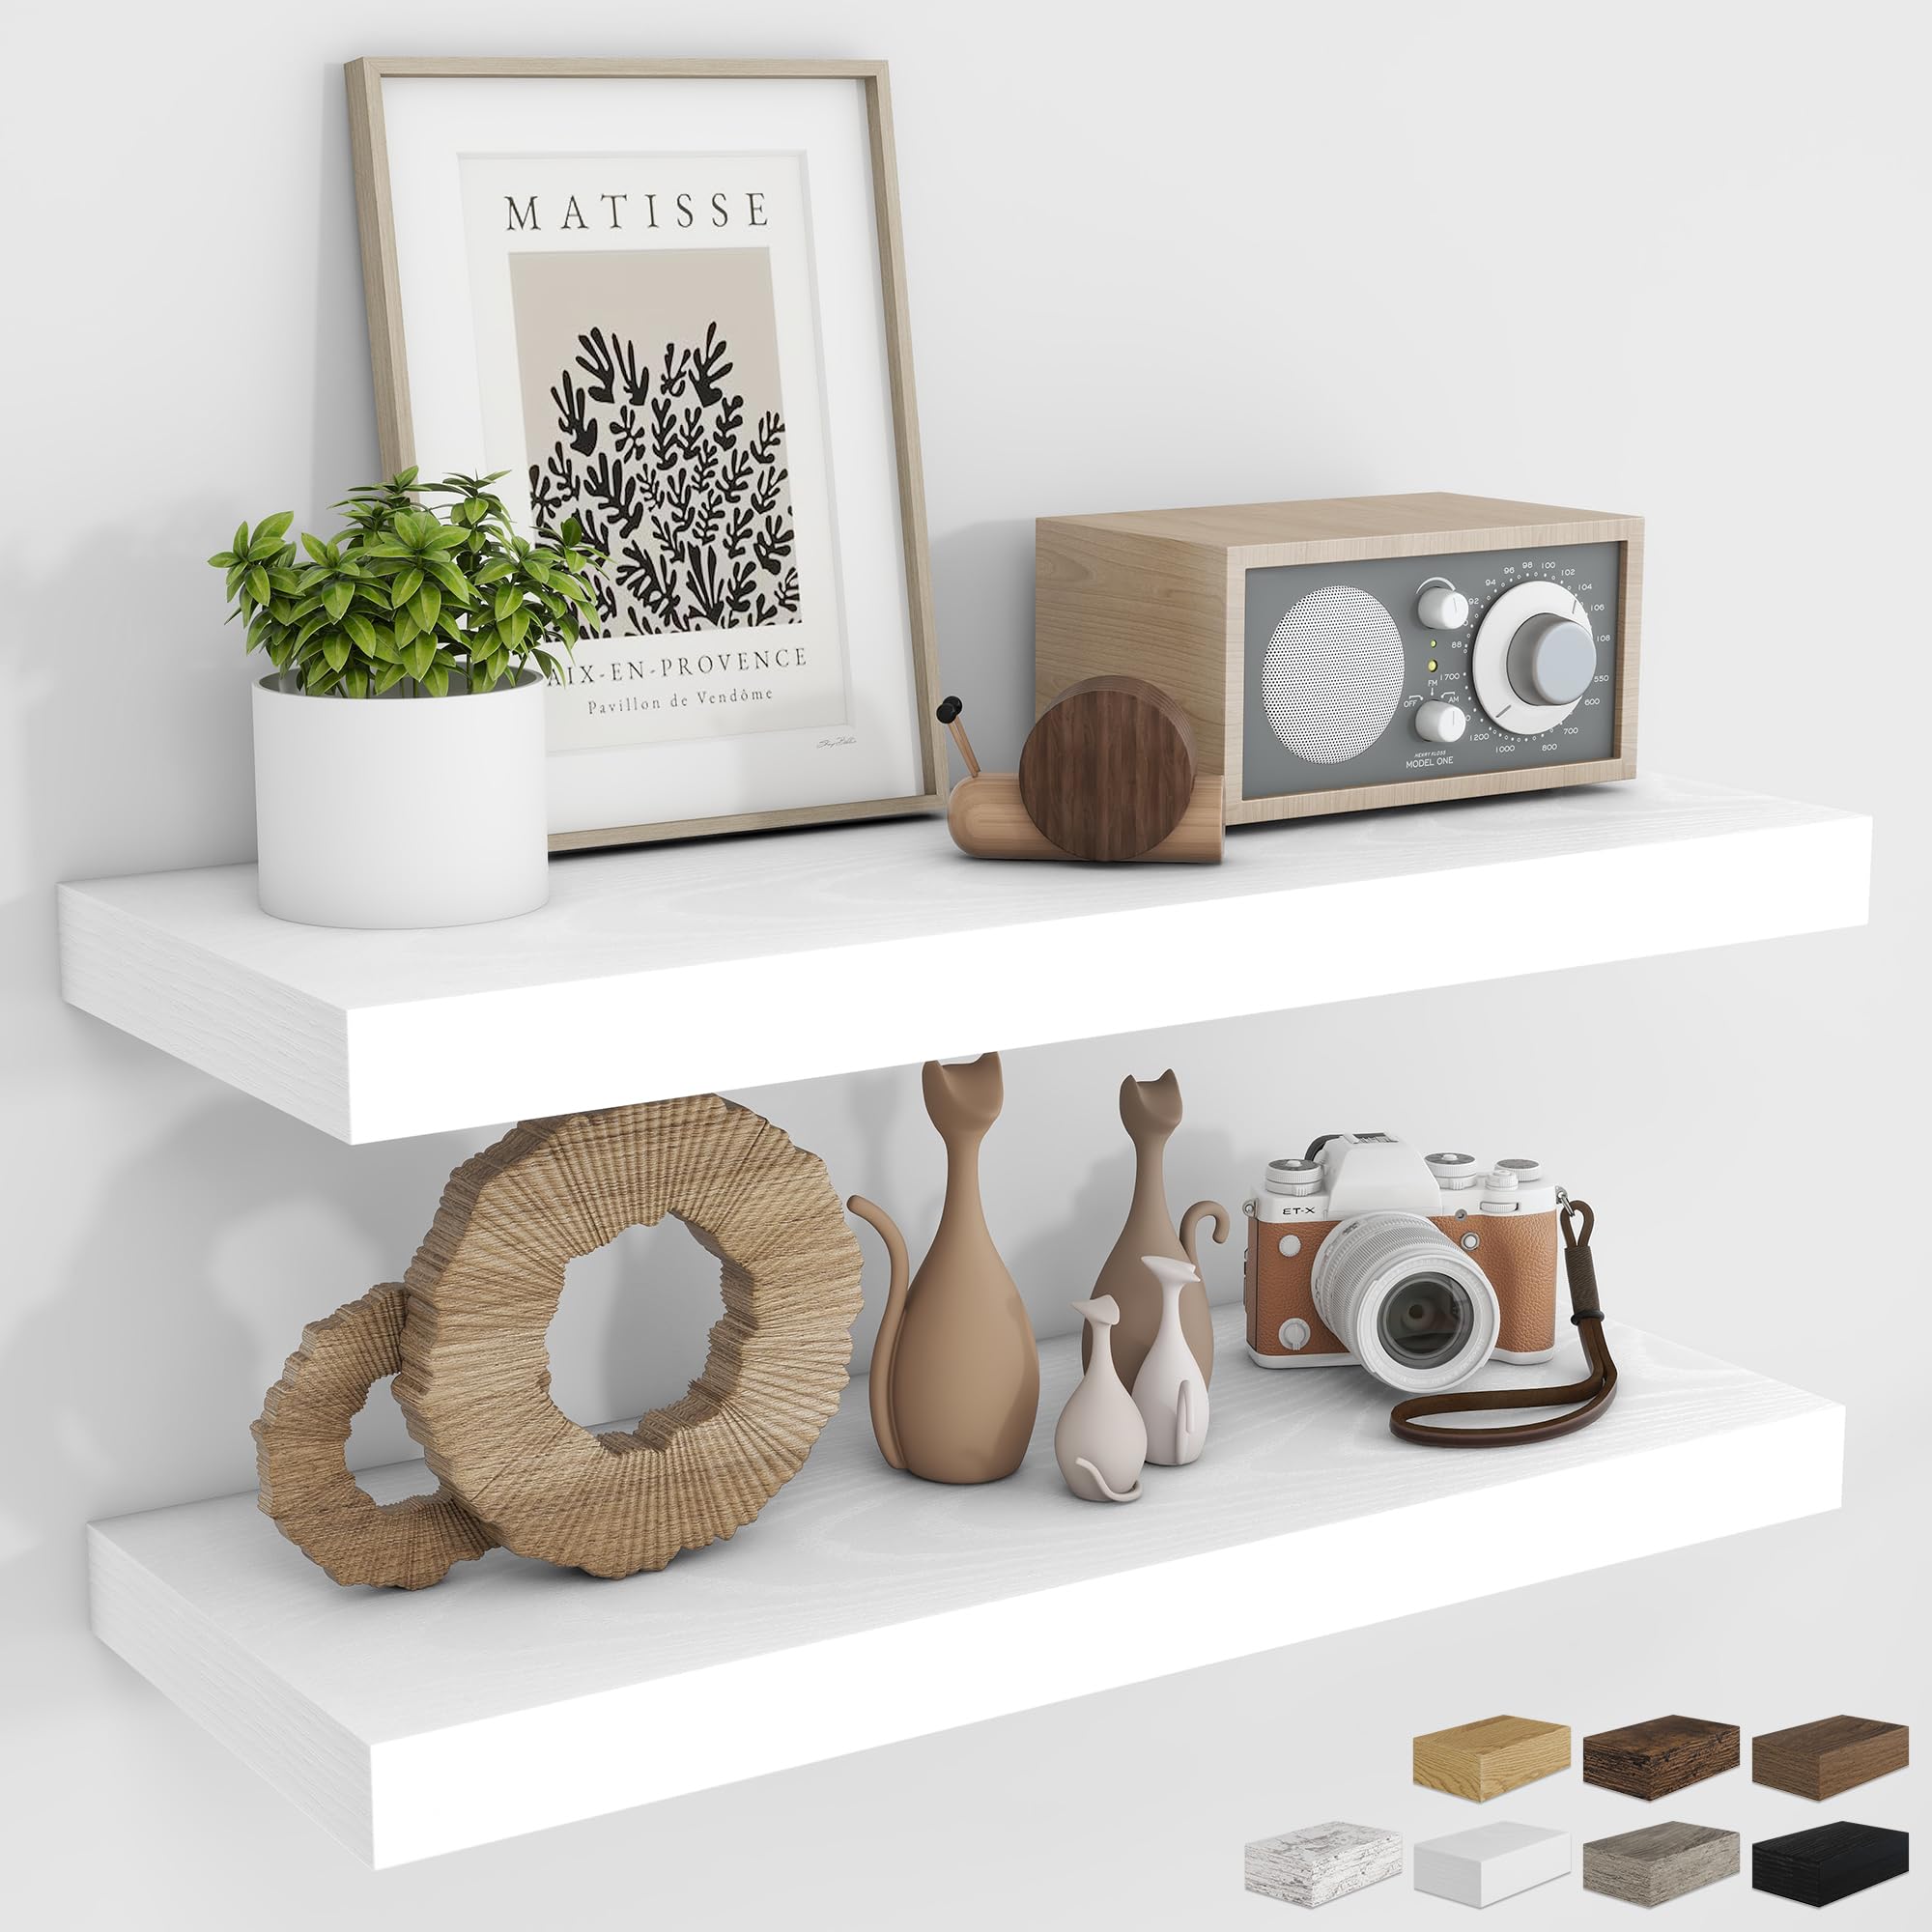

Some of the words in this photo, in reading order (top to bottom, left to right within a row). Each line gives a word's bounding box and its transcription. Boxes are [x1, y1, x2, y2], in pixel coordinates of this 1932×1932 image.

[504, 192, 769, 231] MATISSE
[547, 647, 807, 687] AIX-EN-PROVENCE
[1439, 672, 1461, 681] 1700
[1594, 674, 1609, 683] 550
[588, 696, 661, 715] Pavillon
[669, 693, 688, 708] de
[696, 688, 773, 704] Vendôme
[1404, 699, 1418, 708] OFF
[1584, 697, 1601, 706] 600
[1469, 733, 1490, 742] 1200
[1495, 745, 1516, 753] 1000
[1406, 758, 1435, 769] MODEL
[1436, 755, 1454, 765] ONE
